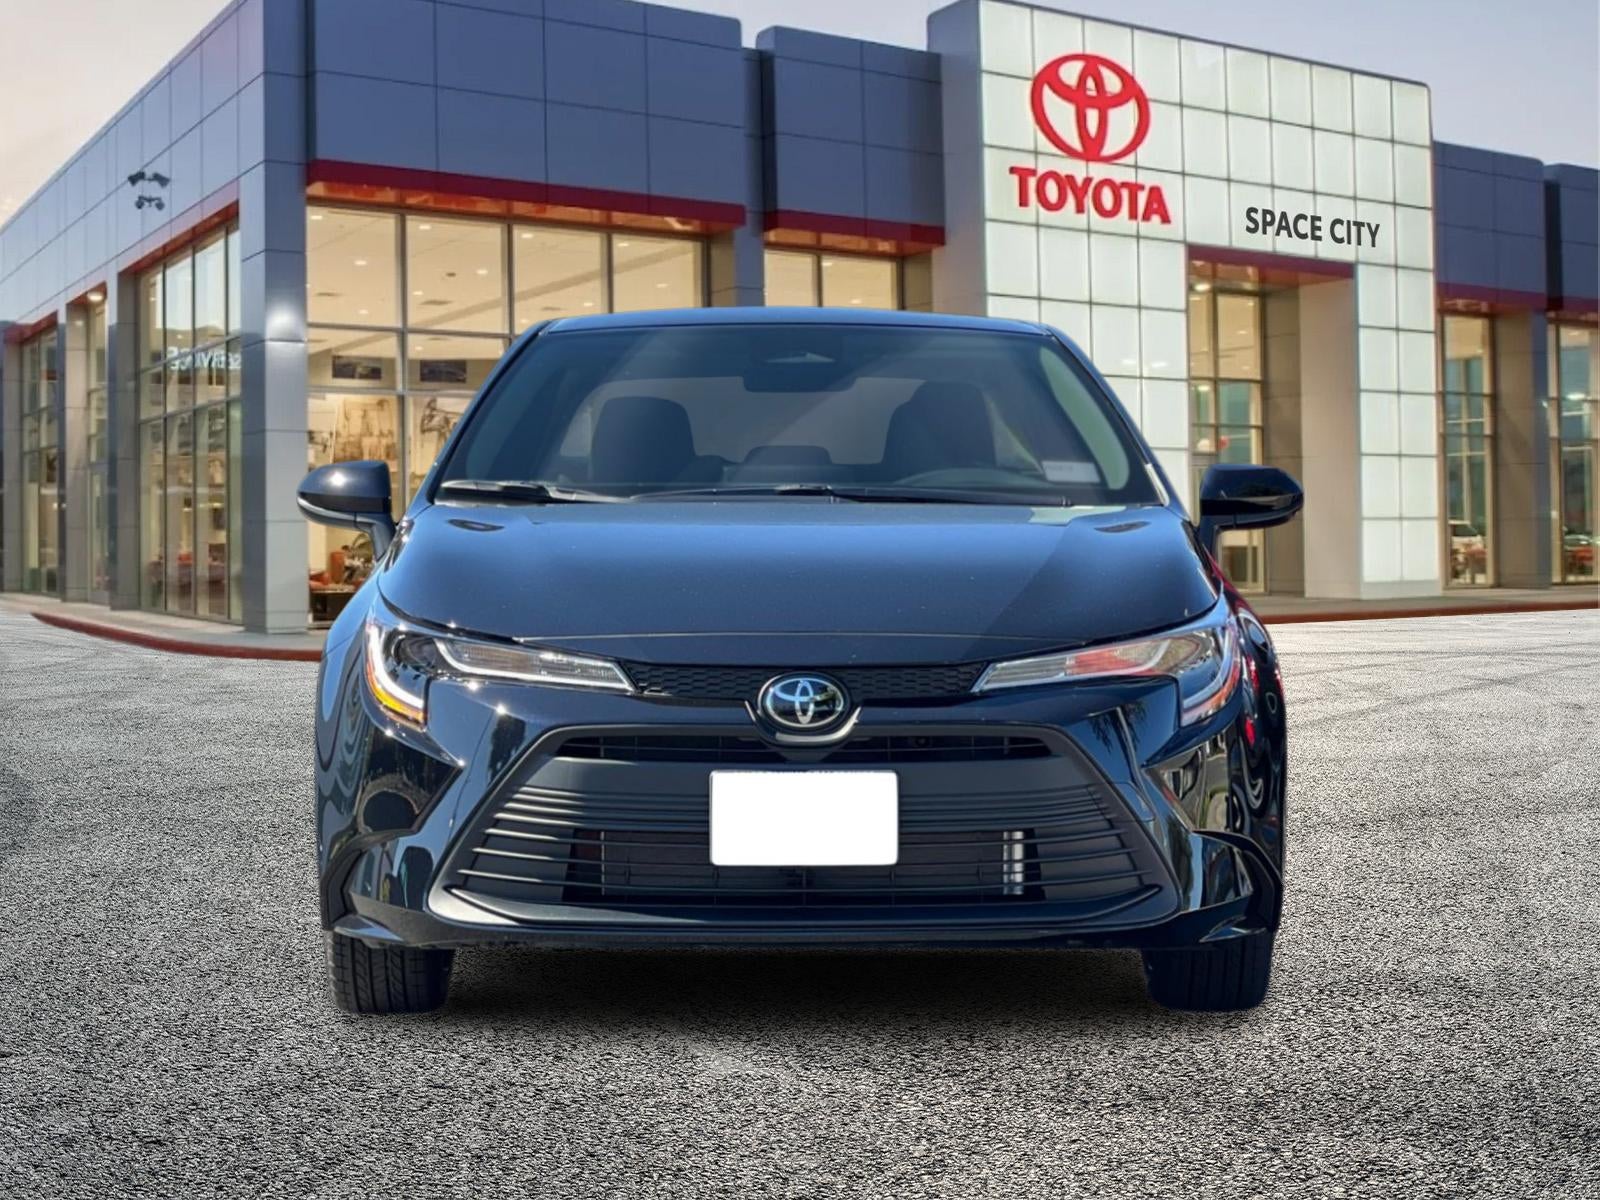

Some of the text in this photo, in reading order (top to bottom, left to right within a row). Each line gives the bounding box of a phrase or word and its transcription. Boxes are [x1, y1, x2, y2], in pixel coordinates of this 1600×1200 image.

[1009, 166, 1171, 224] TOYOTA
[1245, 207, 1380, 248] SPACE CITY
